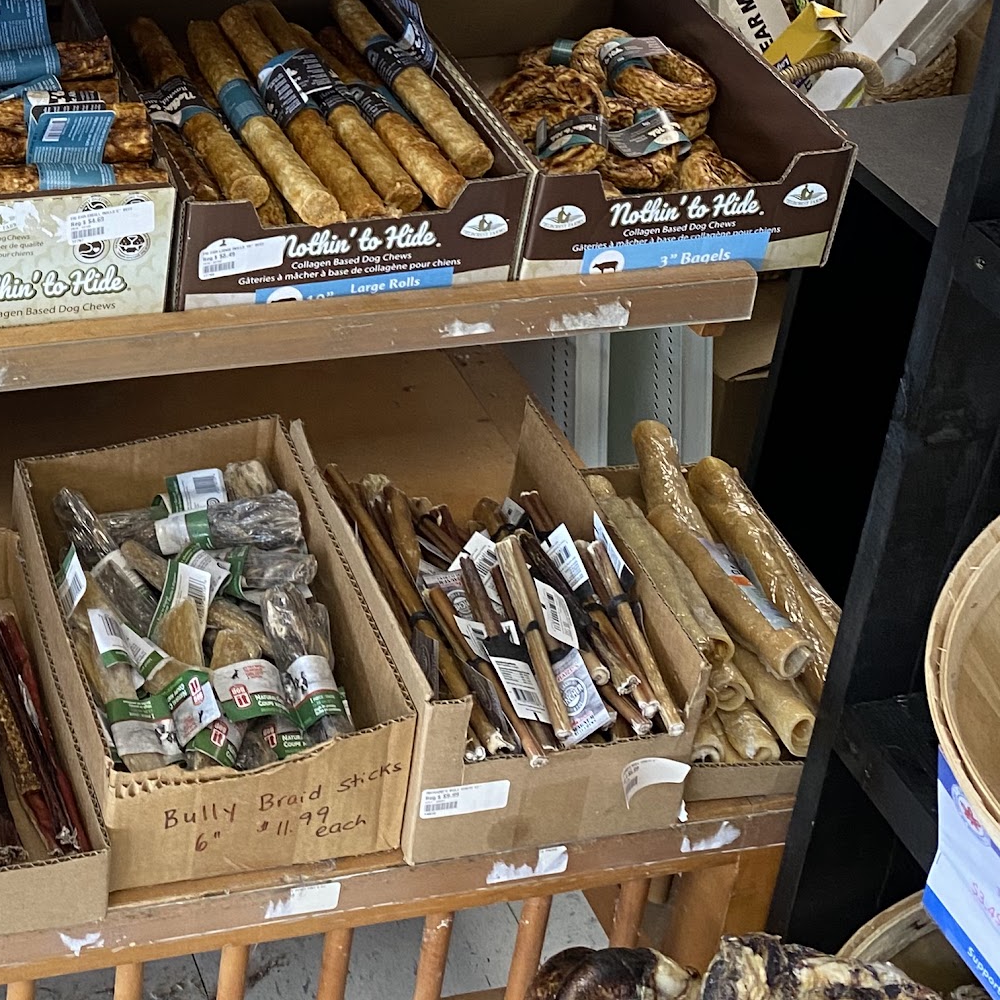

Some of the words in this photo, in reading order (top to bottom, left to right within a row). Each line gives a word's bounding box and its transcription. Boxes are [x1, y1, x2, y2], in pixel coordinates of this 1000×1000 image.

[610, 195, 688, 227] Nothin'
[687, 195, 710, 219] to
[712, 189, 760, 217] Hide
[283, 227, 358, 258] Nothin'
[358, 227, 383, 251] to
[384, 220, 436, 249] Hide
[680, 248, 731, 264] Bagels
[42, 270, 70, 297] to
[69, 264, 127, 295] Hide
[350, 283, 386, 294] Large
[389, 277, 421, 289] Rolls
[164, 803, 237, 830] Bully
[258, 784, 322, 812] Braid
[315, 815, 367, 837] each
